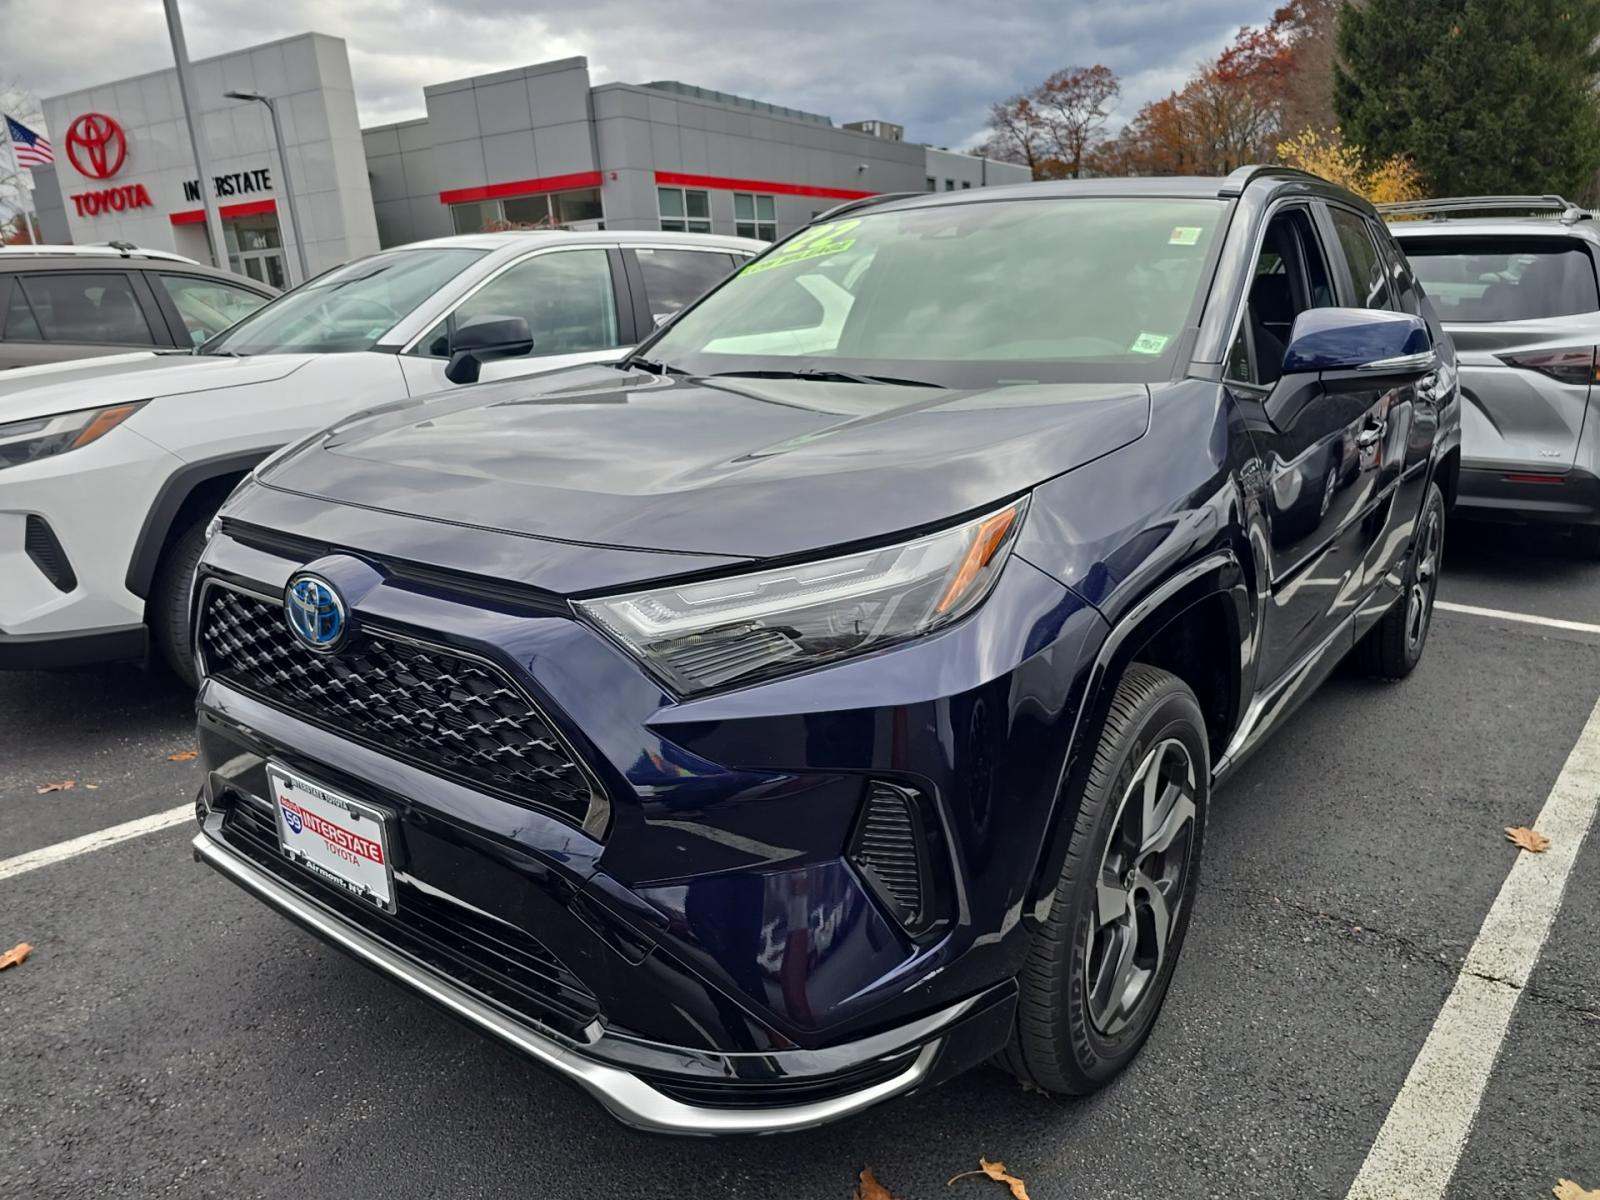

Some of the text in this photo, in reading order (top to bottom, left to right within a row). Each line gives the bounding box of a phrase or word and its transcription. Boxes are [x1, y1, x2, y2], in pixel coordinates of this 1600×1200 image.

[70, 184, 153, 216] TOYOTA
[183, 168, 272, 201] INRSTATE
[285, 810, 380, 861] 59 INTERSTATE
[324, 840, 360, 866] TOYOTA
